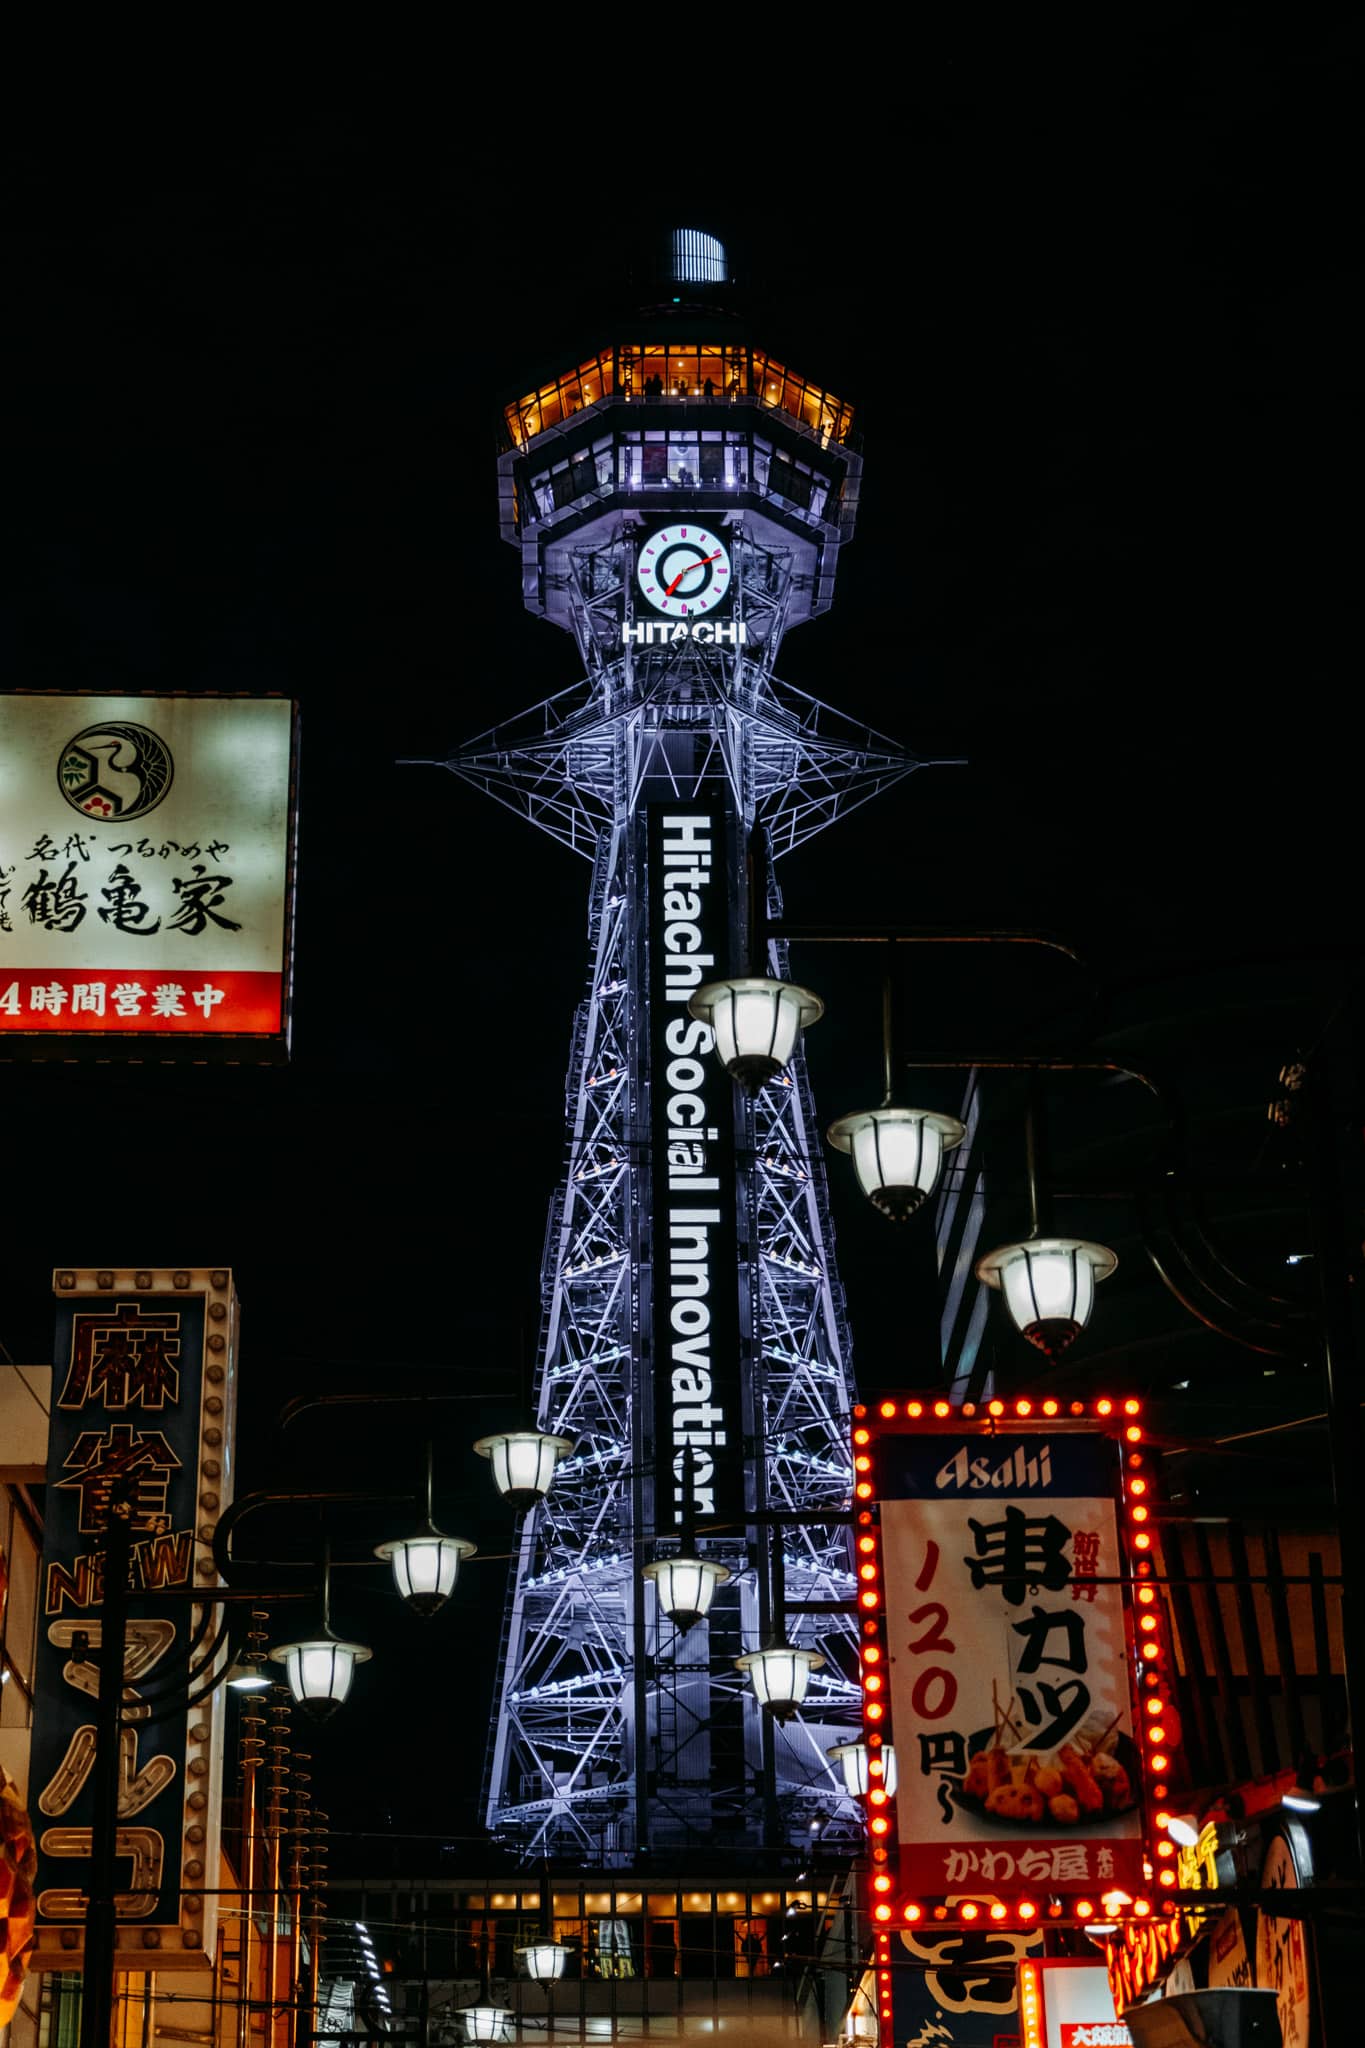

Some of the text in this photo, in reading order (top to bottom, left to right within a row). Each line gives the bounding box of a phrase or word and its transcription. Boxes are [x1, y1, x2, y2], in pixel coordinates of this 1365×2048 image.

[622, 621, 746, 645] HITACHI
[25, 833, 230, 862] 名代 つるかめや
[21, 861, 242, 936] 鶴亀家
[666, 1018, 720, 1190] Social
[669, 1209, 726, 1526] Innovation
[53, 1303, 183, 1534] 麻雀
[935, 1444, 1053, 1490] Asahi
[963, 1505, 1091, 1752] 串カツ
[943, 1844, 1091, 1883] かわち屋
